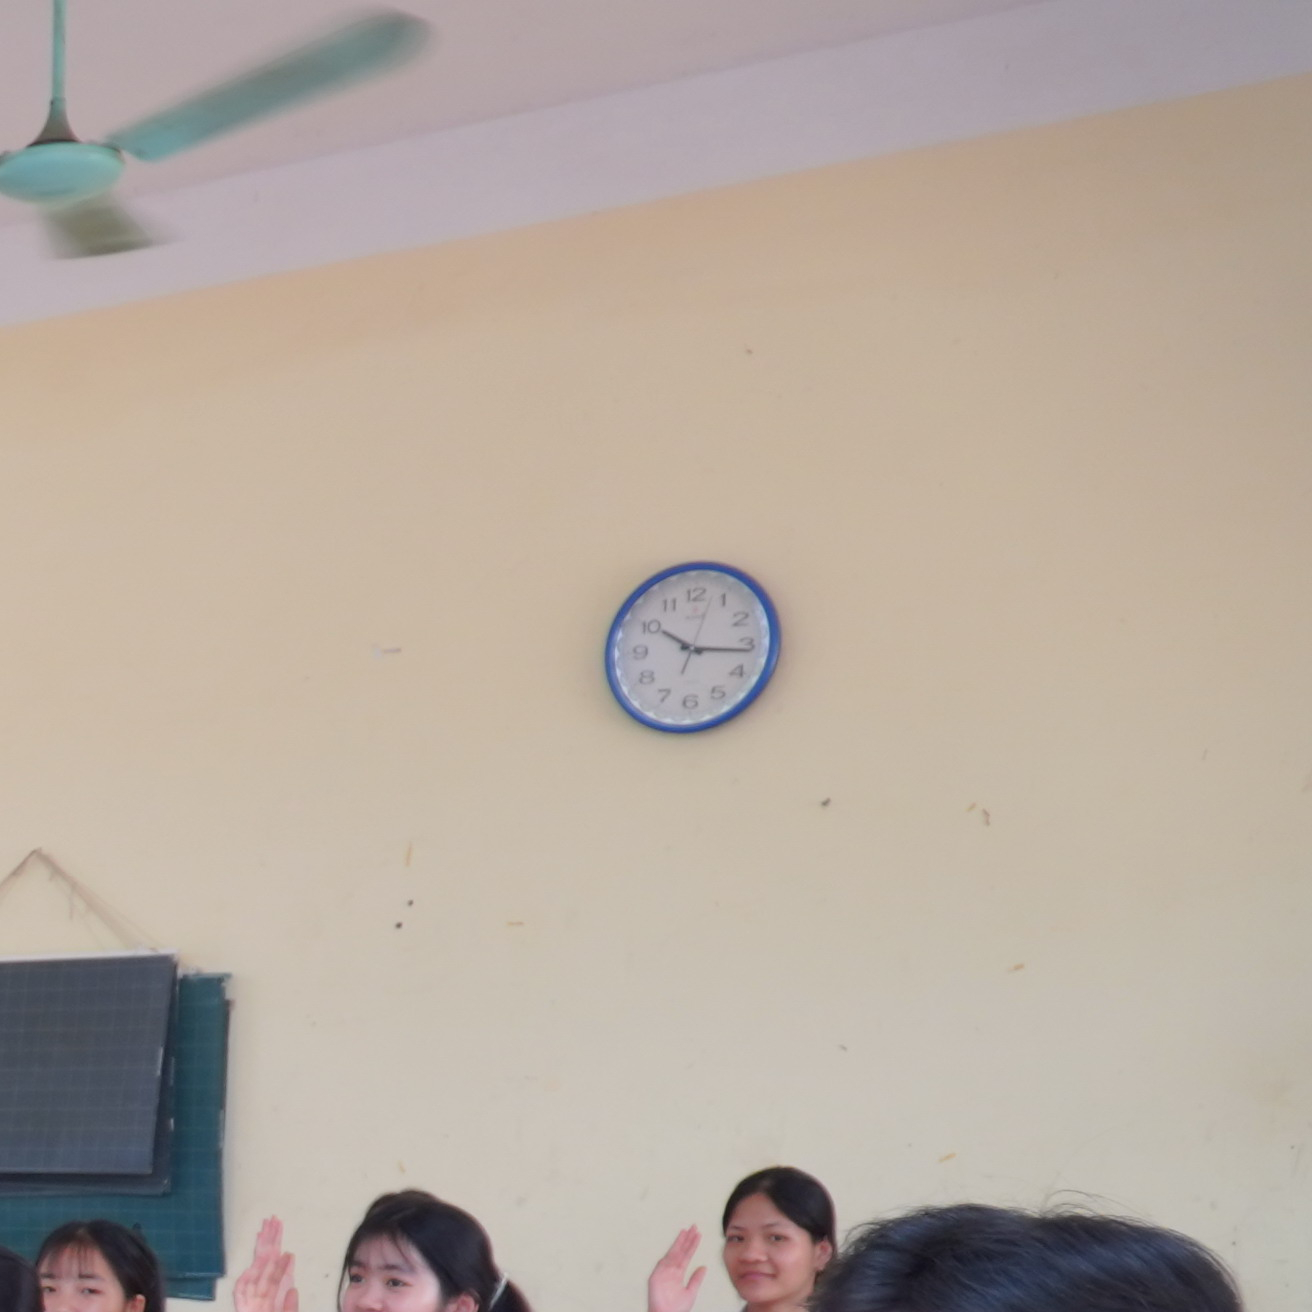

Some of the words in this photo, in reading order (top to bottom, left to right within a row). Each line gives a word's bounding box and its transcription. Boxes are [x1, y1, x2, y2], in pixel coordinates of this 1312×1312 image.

[687, 587, 707, 603] 12
[721, 593, 726, 607] 1
[664, 598, 677, 613] 11
[733, 612, 750, 627] 2
[643, 620, 662, 634] 10
[740, 637, 756, 651] 3
[633, 645, 649, 660] 9
[639, 671, 655, 685] 8
[729, 664, 745, 678] 4
[658, 689, 672, 703] 7
[711, 686, 726, 700] 5
[683, 695, 699, 710] 6
